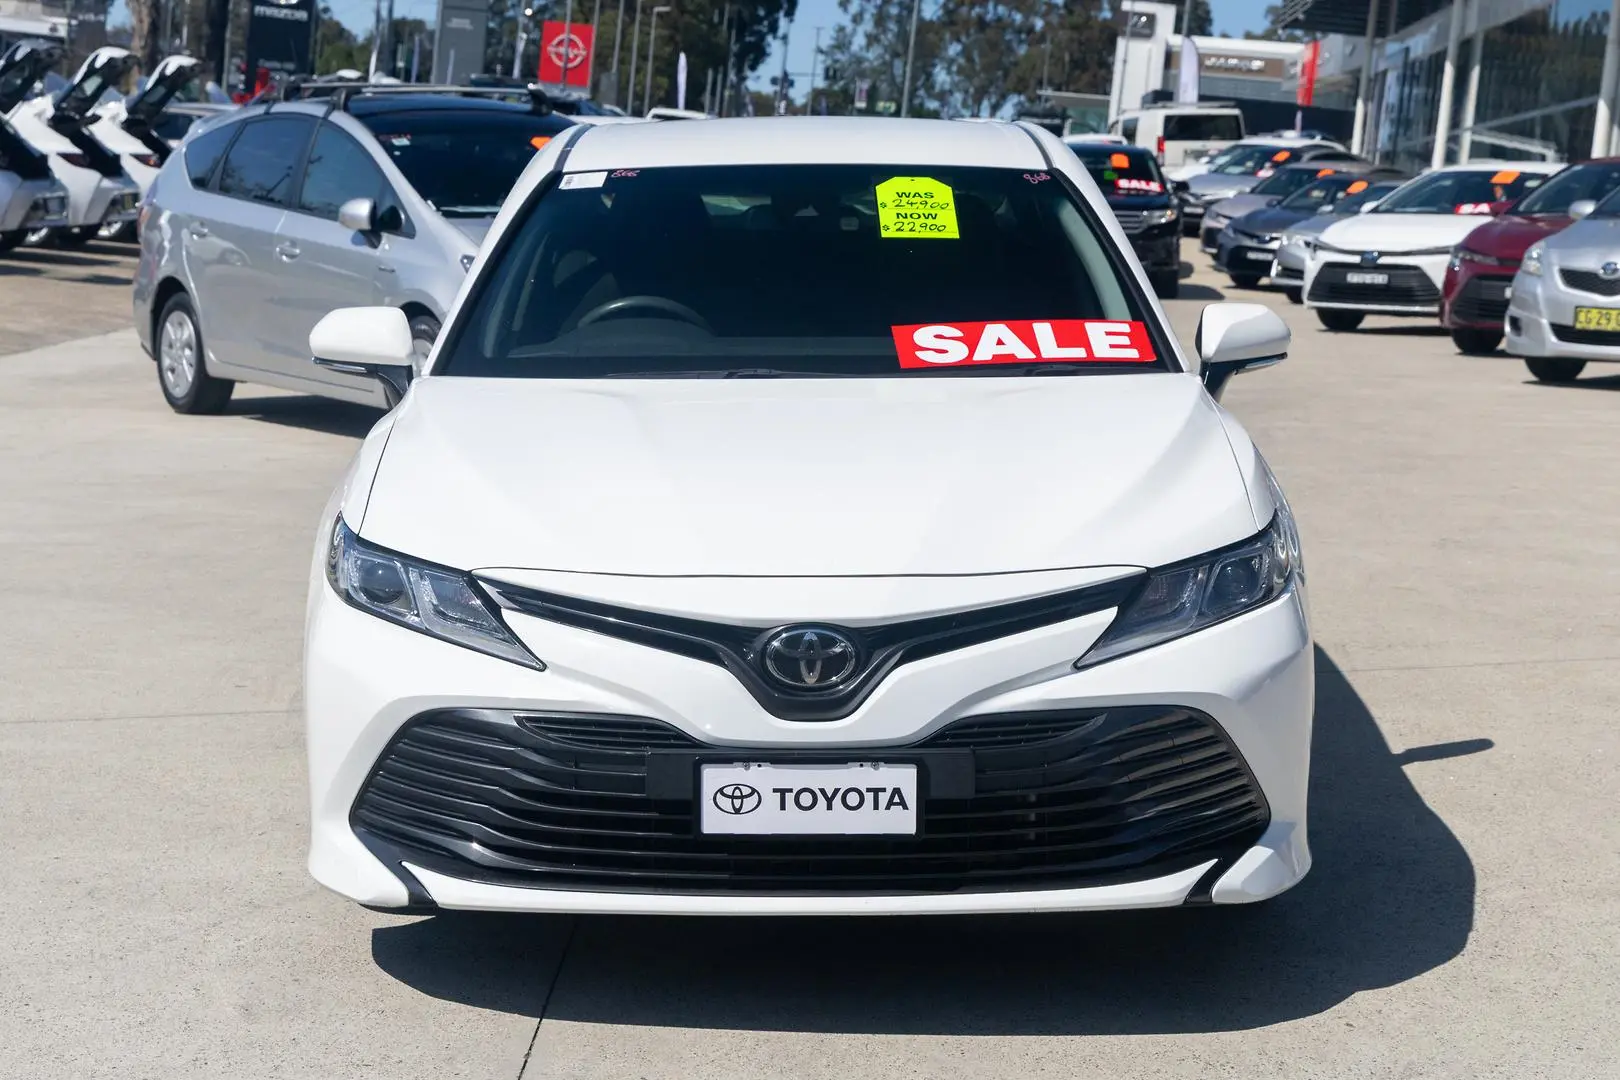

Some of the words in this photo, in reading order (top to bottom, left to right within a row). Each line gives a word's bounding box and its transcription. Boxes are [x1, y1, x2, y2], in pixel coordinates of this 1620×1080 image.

[896, 191, 935, 199] WAS
[896, 212, 938, 220] NOW
[912, 322, 1140, 364] SALE
[772, 787, 910, 812] TOYOTA
